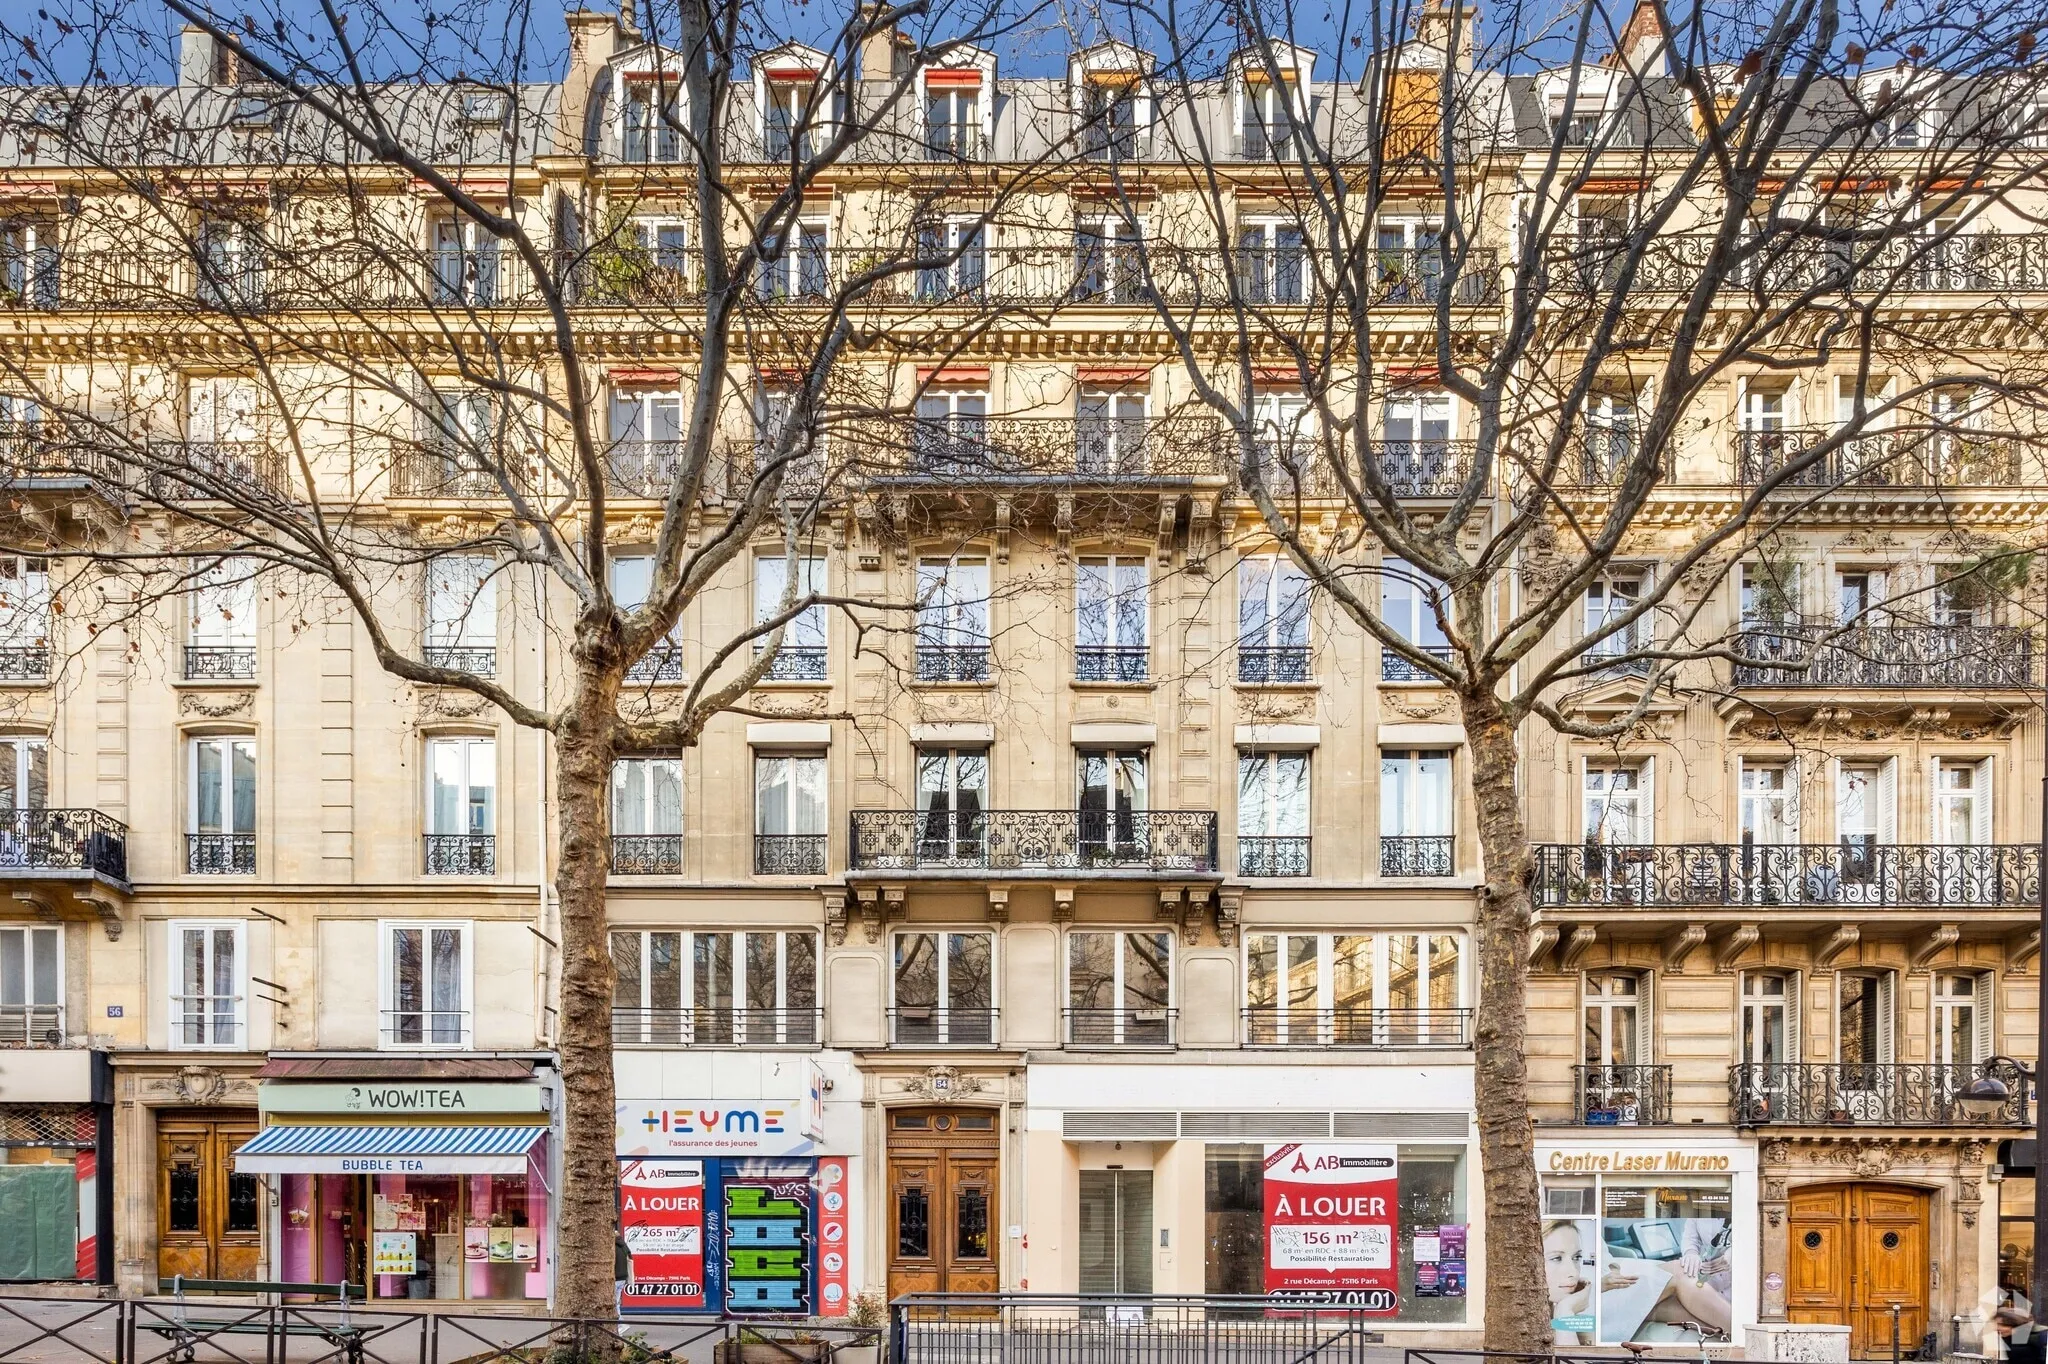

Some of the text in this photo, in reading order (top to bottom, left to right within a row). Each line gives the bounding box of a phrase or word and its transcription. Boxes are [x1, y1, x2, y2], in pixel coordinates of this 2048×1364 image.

[110, 1007, 121, 1016] 56
[936, 1080, 947, 1088] 54
[368, 1089, 465, 1108] WOW!TEA
[642, 1110, 785, 1133] HEYME
[668, 1139, 758, 1148] l'assurance des jeunes
[343, 1160, 423, 1170] BUBBLE TEA
[1314, 1156, 1340, 1170] AB
[1550, 1151, 1729, 1170] Centre Laser Murano
[649, 1169, 665, 1178] AB
[624, 1195, 699, 1211] À LOUER
[1274, 1194, 1386, 1216] À LOUER
[642, 1229, 662, 1237] 265
[665, 1228, 680, 1237] m²
[1303, 1231, 1330, 1244] 156
[1336, 1231, 1359, 1244] m²
[1303, 1277, 1335, 1285] Décamps
[627, 1285, 697, 1295] 01 47 27 01 01
[1370, 1291, 1390, 1309] 01
